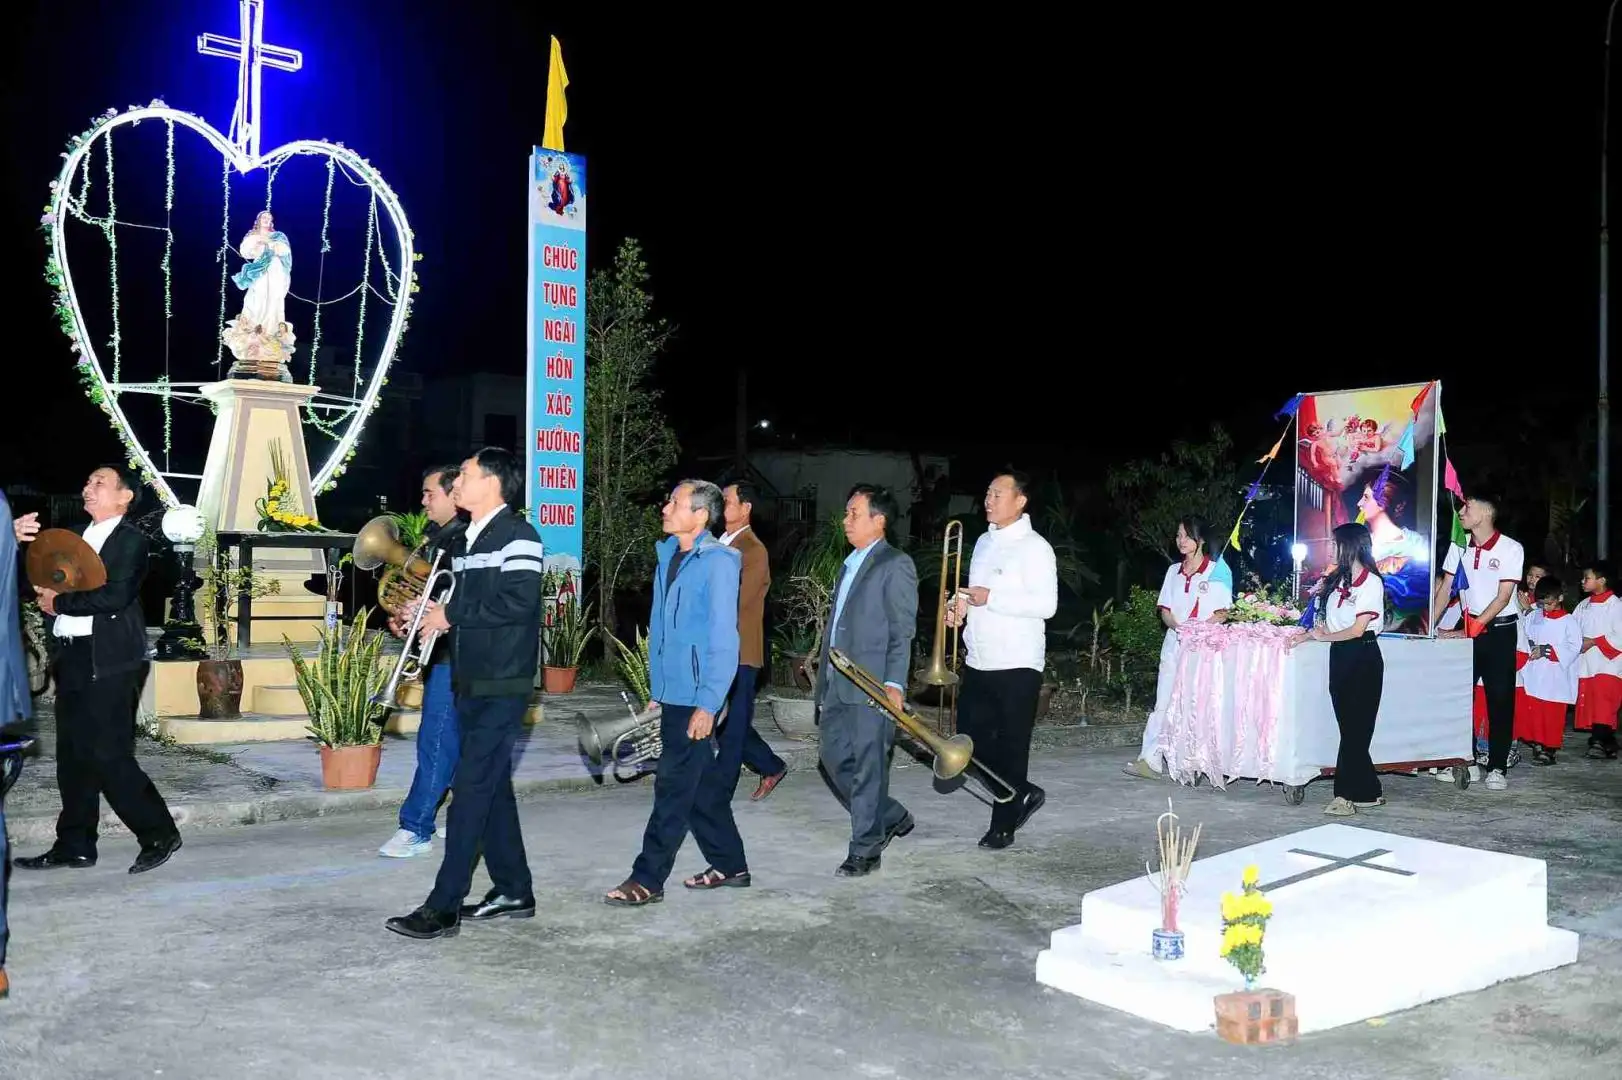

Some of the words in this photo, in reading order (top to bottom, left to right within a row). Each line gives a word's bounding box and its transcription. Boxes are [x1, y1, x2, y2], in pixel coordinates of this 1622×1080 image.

[544, 243, 577, 270] CHÚC
[543, 283, 577, 309] TỤNG
[545, 318, 575, 343] NGÀI
[547, 390, 572, 416] XÁC
[539, 463, 576, 489] THIÊN
[540, 503, 575, 526] CUNG
